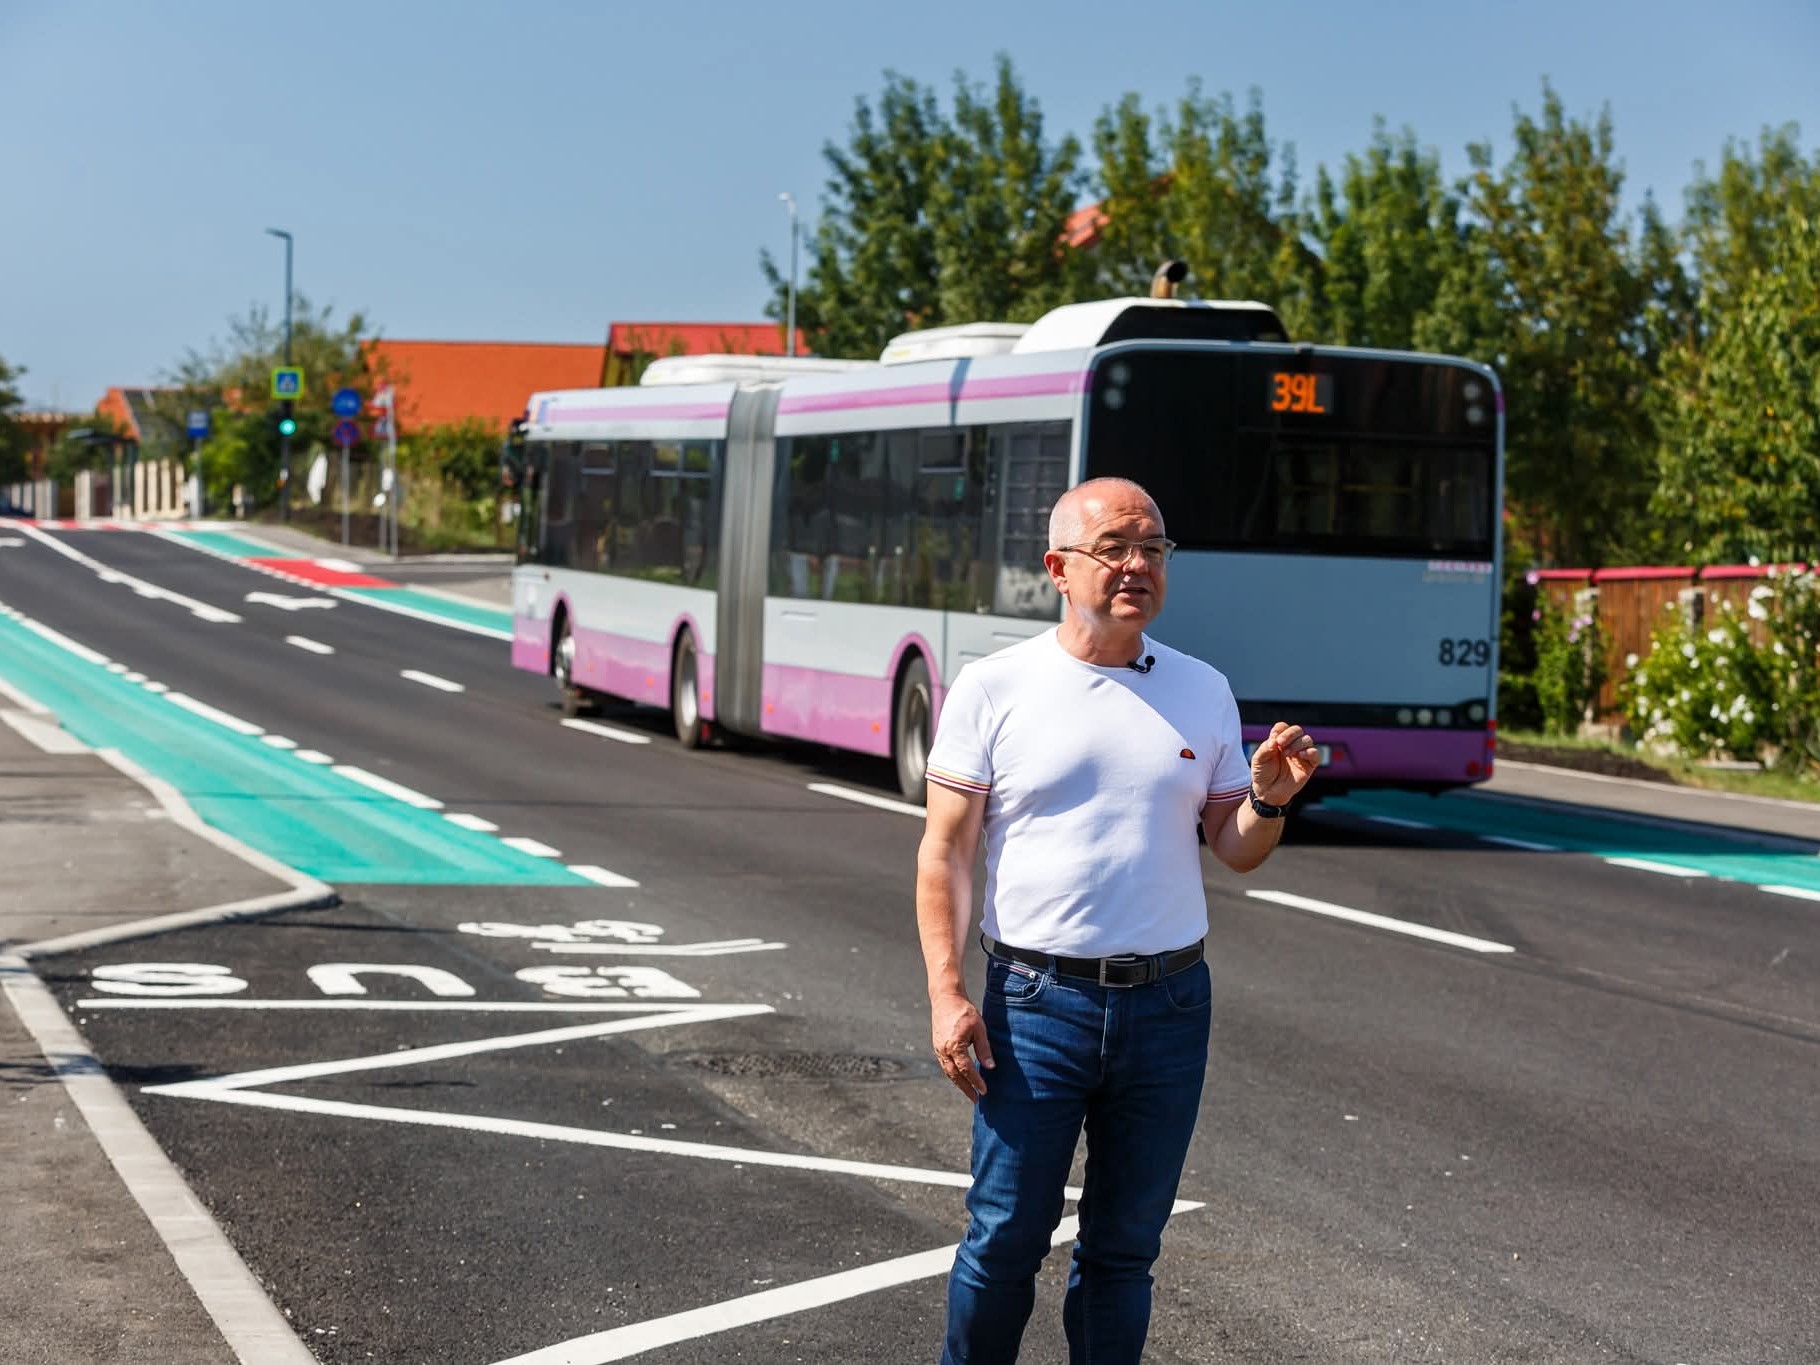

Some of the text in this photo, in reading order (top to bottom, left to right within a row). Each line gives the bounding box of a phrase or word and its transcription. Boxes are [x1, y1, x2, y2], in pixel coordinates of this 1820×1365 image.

[1271, 372, 1325, 413] 39L
[1439, 638, 1490, 667] 829
[91, 962, 701, 998] BUS
